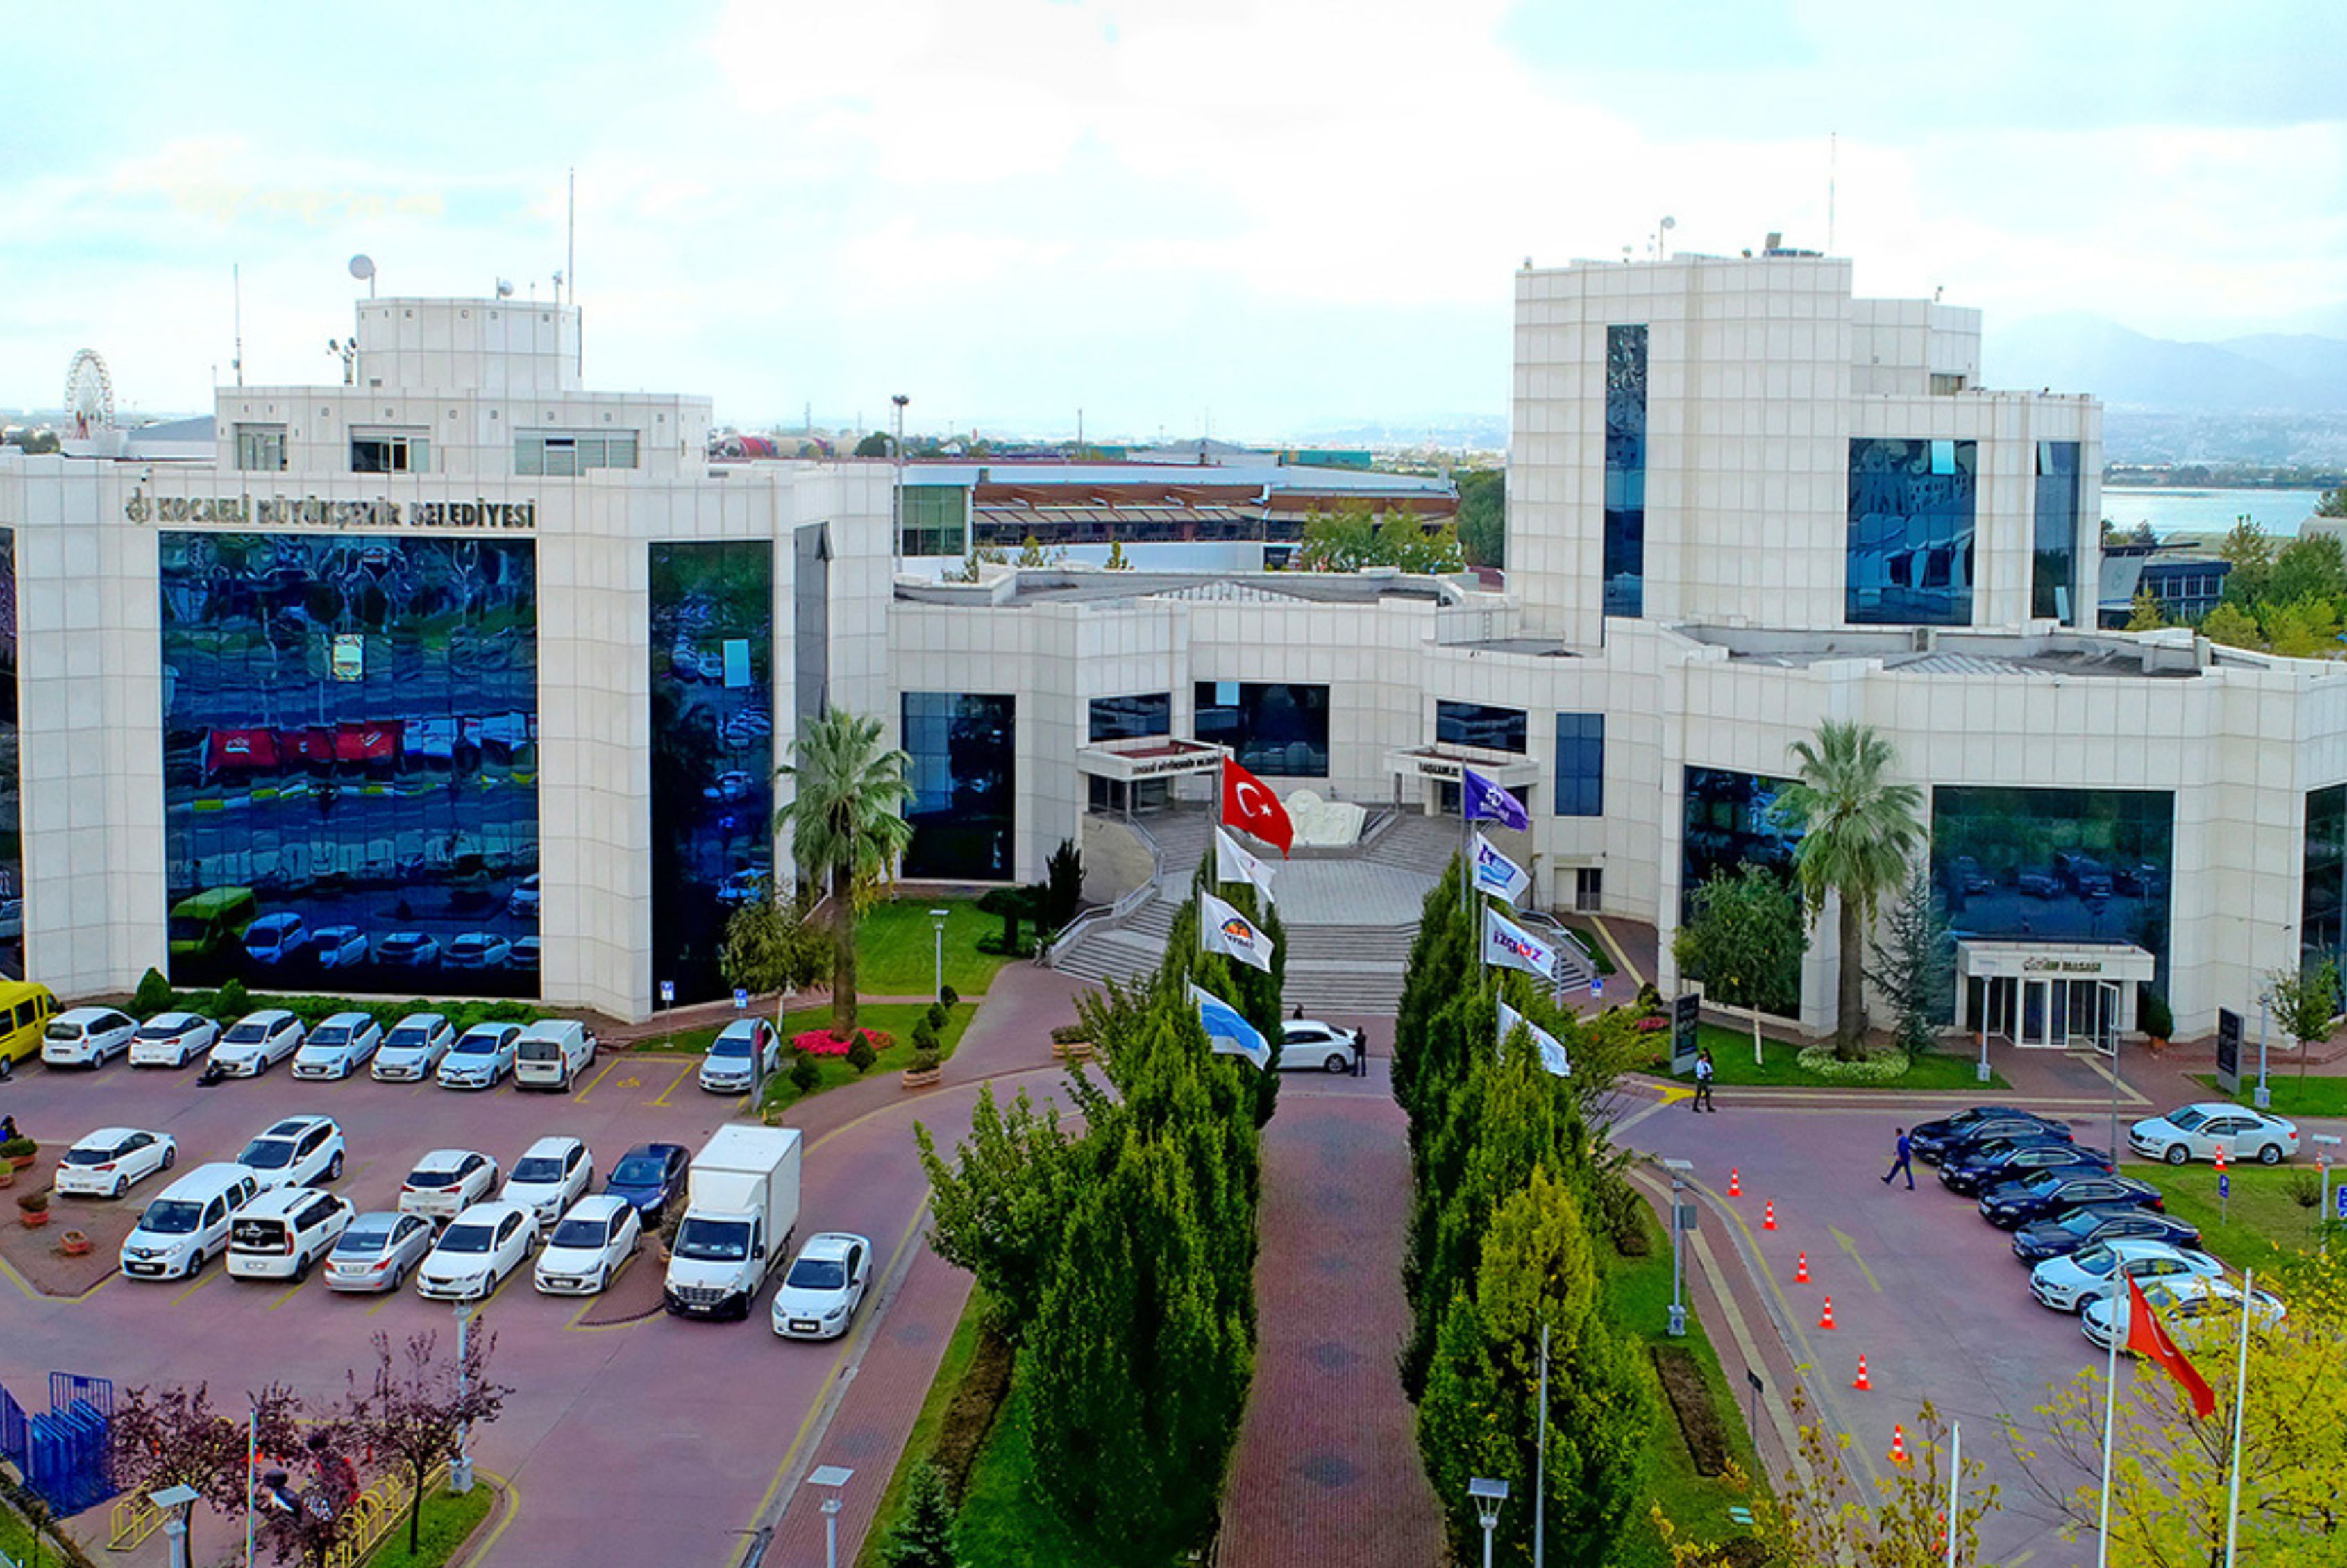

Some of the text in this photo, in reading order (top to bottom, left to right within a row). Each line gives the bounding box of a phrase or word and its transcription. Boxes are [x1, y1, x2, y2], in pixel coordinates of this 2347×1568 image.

[157, 493, 535, 531] KOCAELİ BÜYÜKŞEHİR BELEDİYESİ
